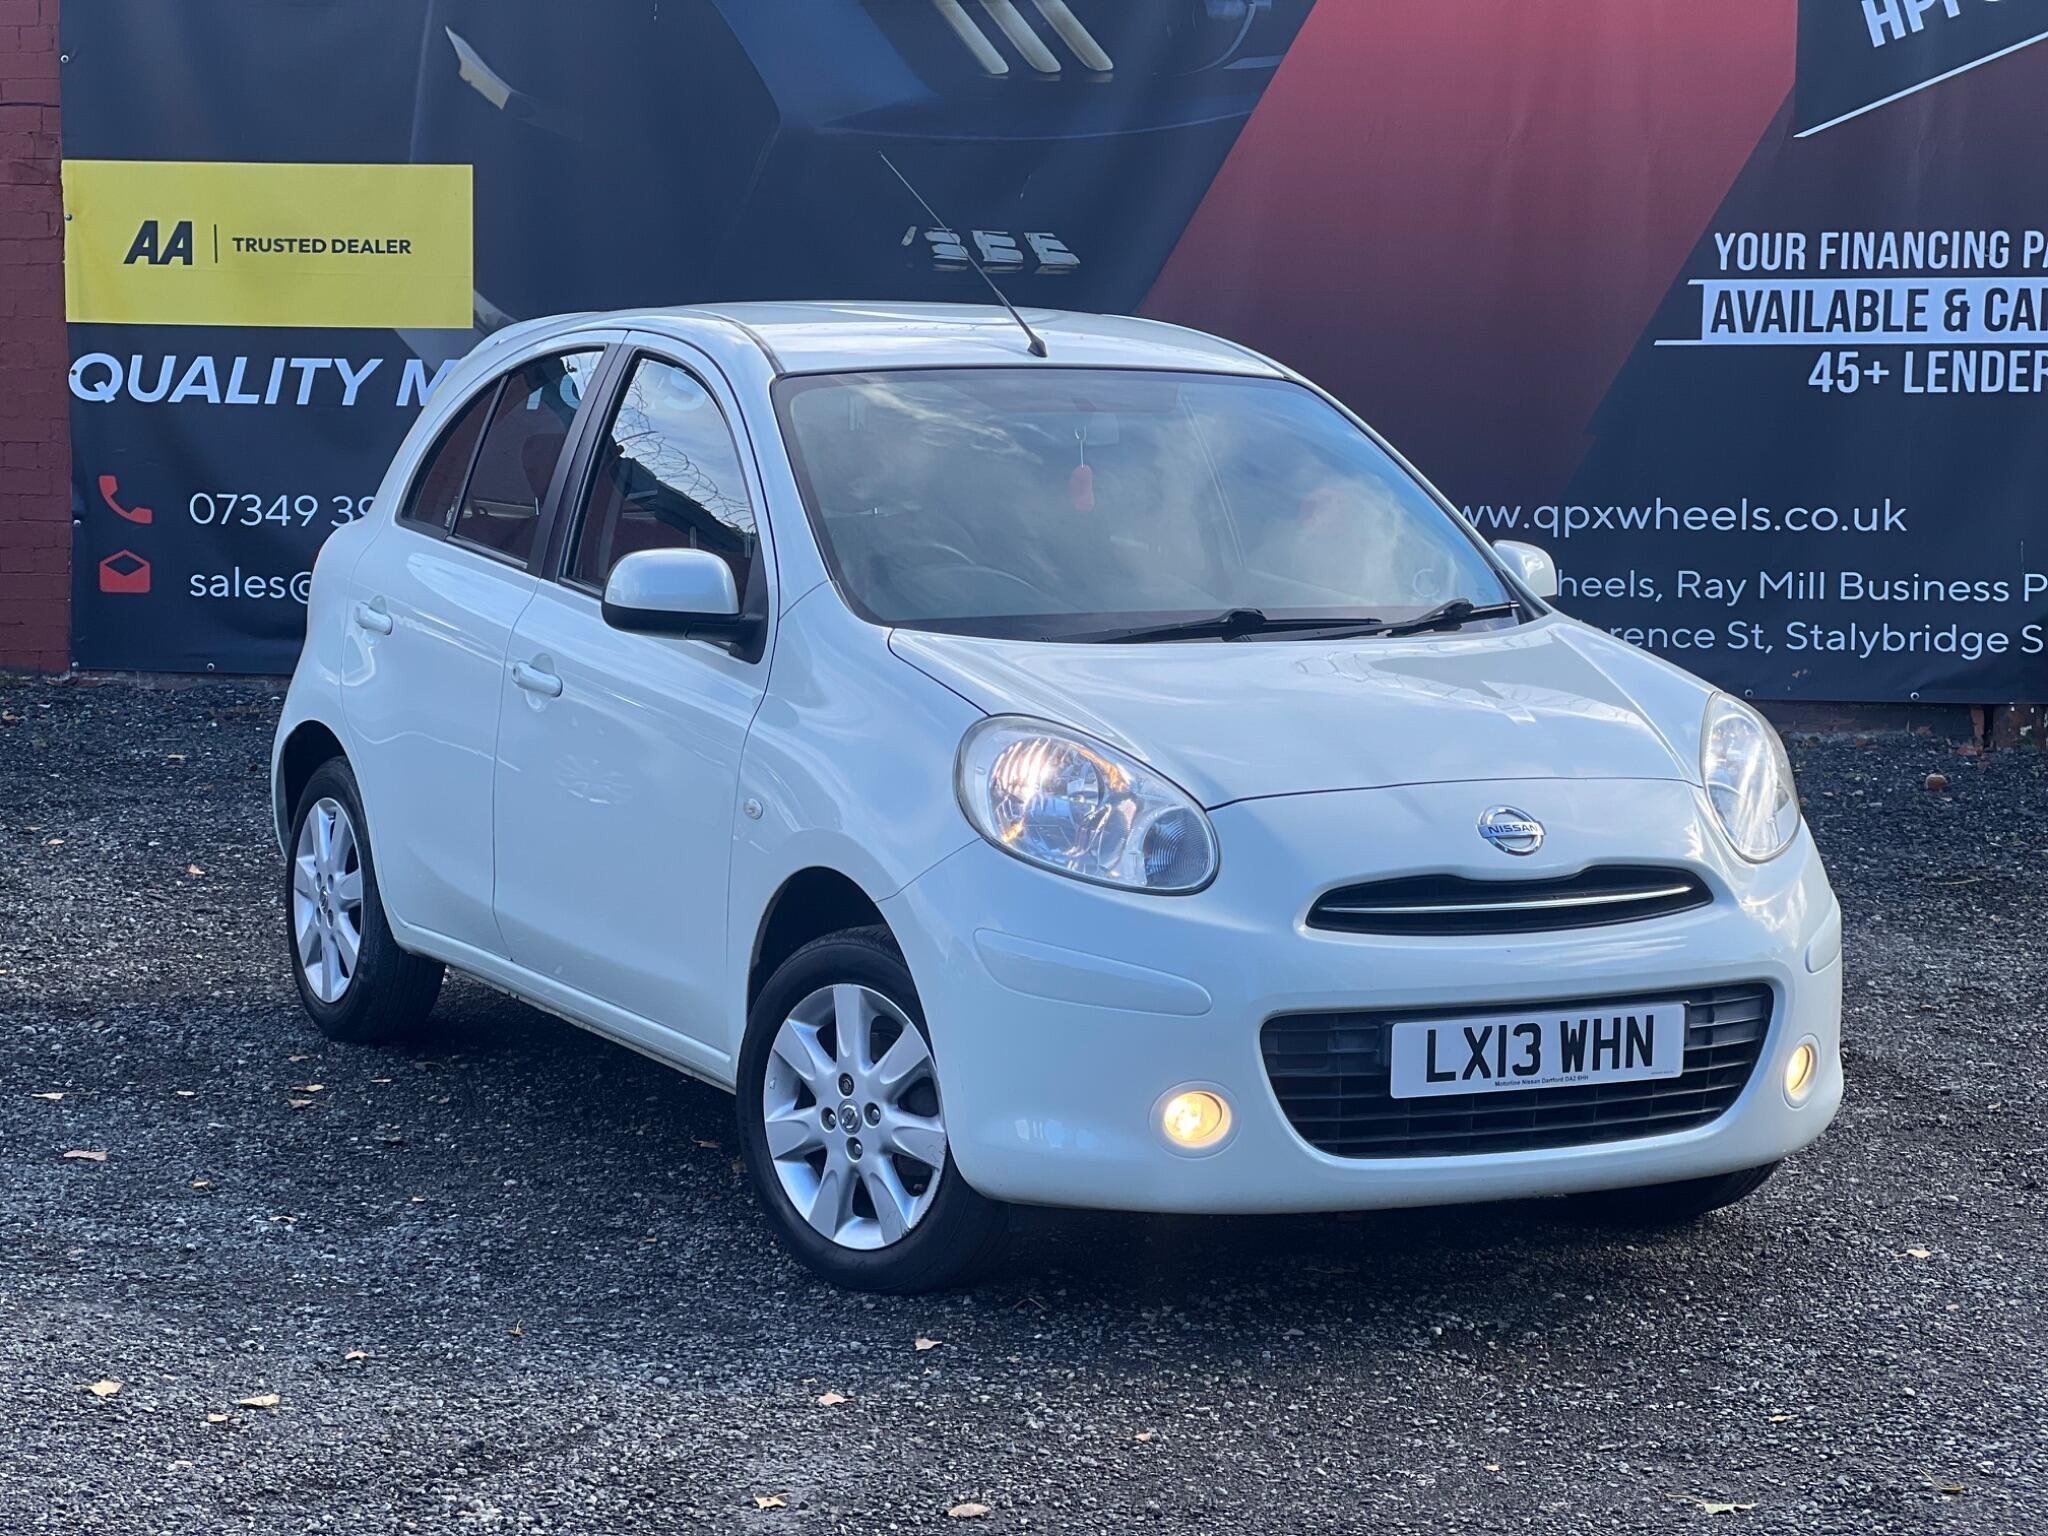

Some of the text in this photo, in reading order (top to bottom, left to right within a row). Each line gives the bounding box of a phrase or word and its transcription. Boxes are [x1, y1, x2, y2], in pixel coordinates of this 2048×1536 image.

[123, 220, 193, 265] AA
[231, 237, 412, 255] TRUSTED DEALER
[1714, 231, 1807, 271] YOUR
[1819, 230, 2010, 270] FINANCING
[1710, 288, 1930, 334] AVAILABLE
[1943, 288, 1971, 332] &
[68, 352, 384, 406] QUALITY
[1808, 351, 1890, 394] 45+
[189, 492, 319, 527] 07349
[1462, 497, 1908, 538] ww.qpxwheels.co.uk
[1558, 568, 1663, 603] heels,
[1677, 570, 1747, 607] Ray
[1759, 571, 1825, 600] Mill
[1840, 571, 2010, 602] Business
[1727, 620, 1775, 654] St,
[1786, 621, 2009, 661] Stalybridge
[1487, 824, 1538, 835] NISSAN
[1426, 1014, 1654, 1083] LX13 WHN
